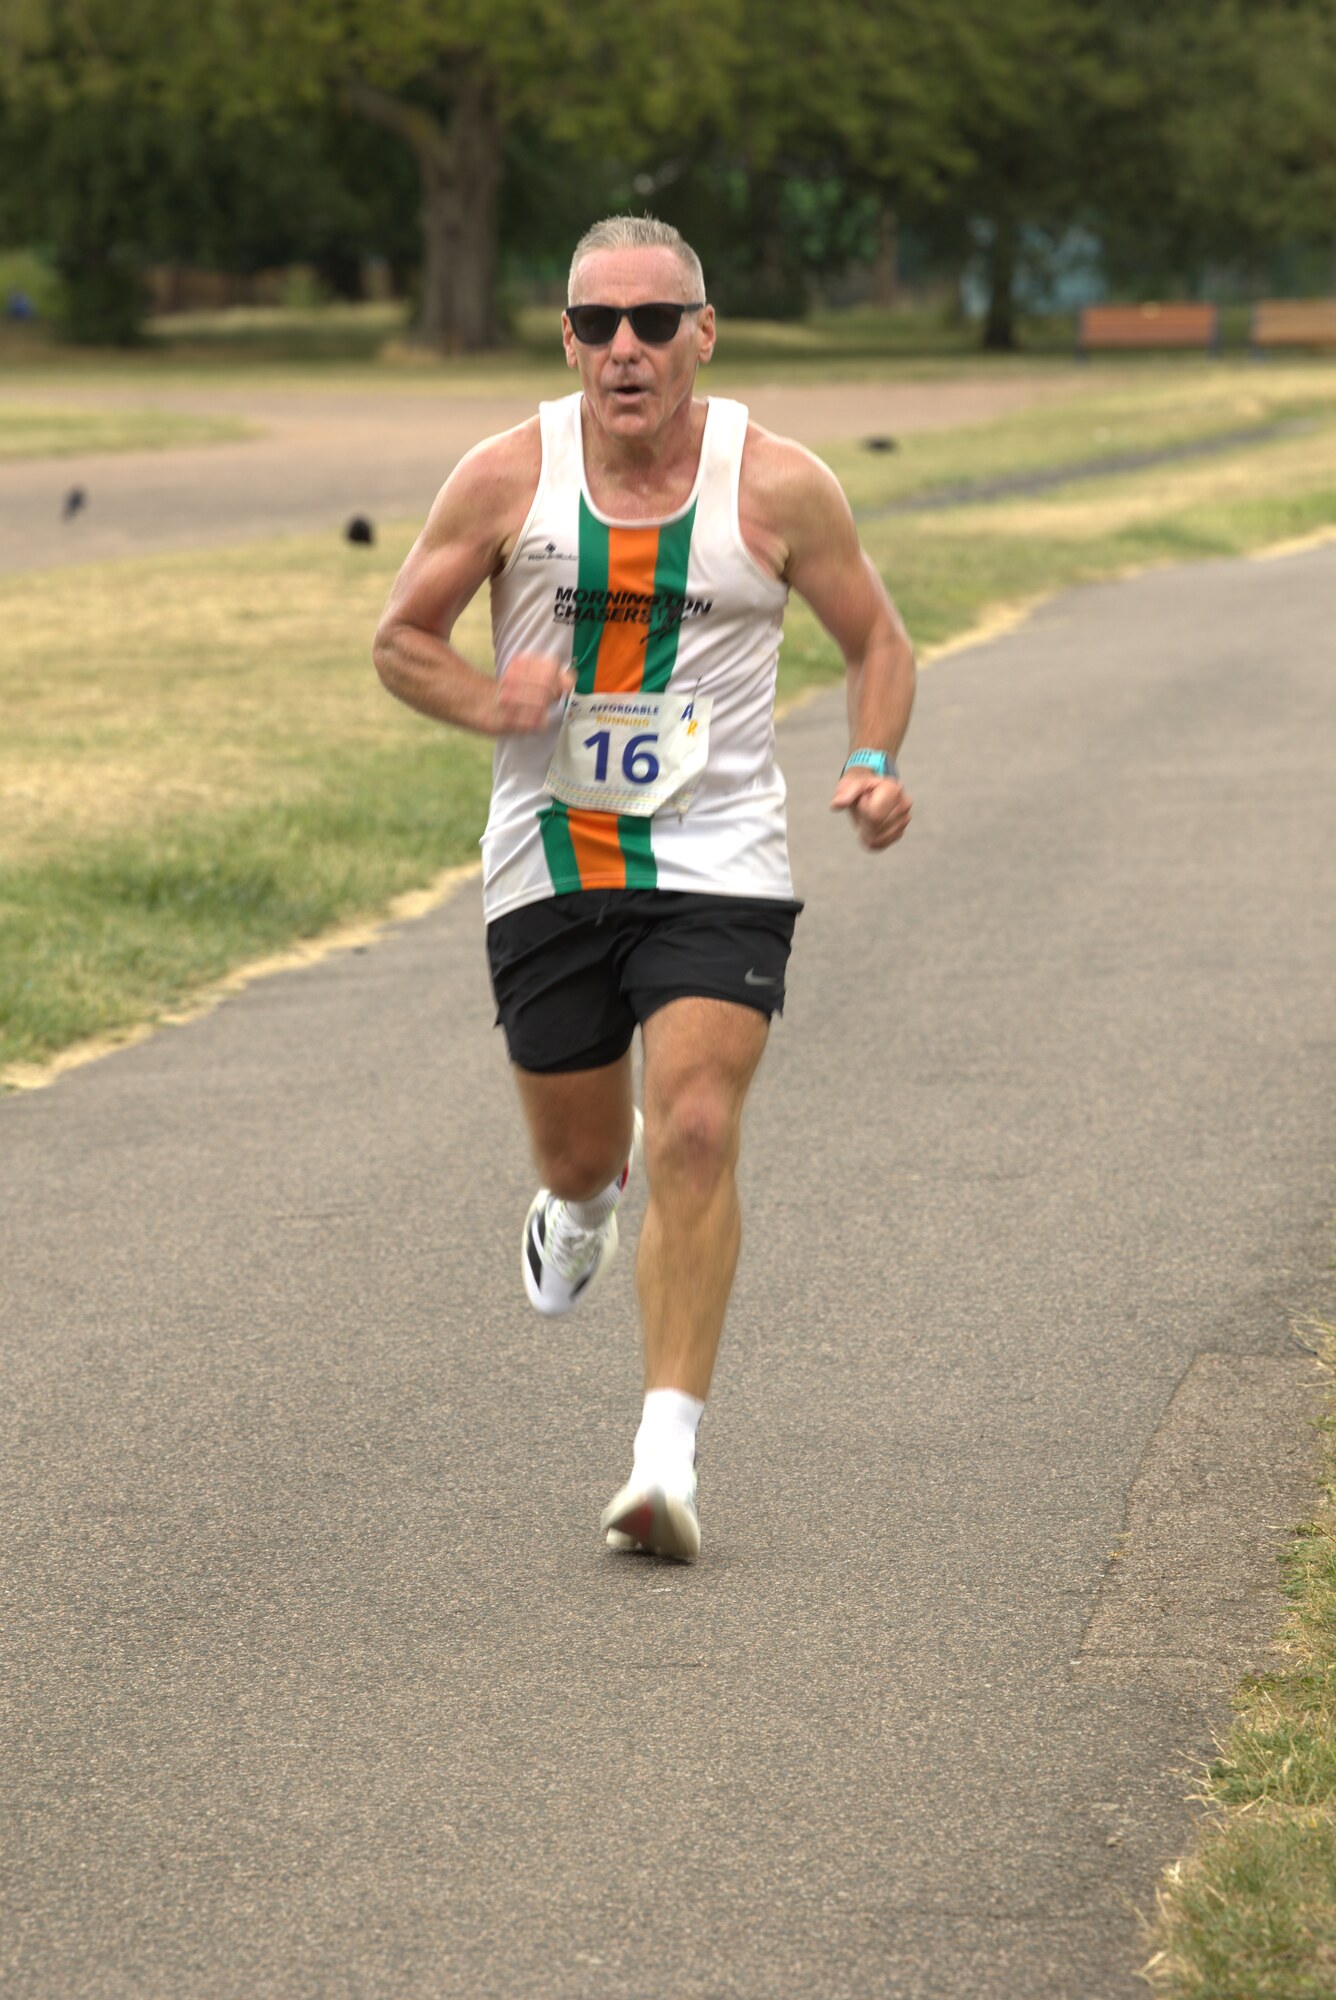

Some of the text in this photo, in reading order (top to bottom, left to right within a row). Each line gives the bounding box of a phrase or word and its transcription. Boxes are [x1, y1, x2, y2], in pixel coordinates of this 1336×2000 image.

[555, 587, 712, 615] MORNINGTON
[554, 604, 653, 624] CHASERS
[590, 703, 660, 716] AFFORDABLE
[596, 714, 649, 728] RUNNING
[583, 730, 660, 784] 16
